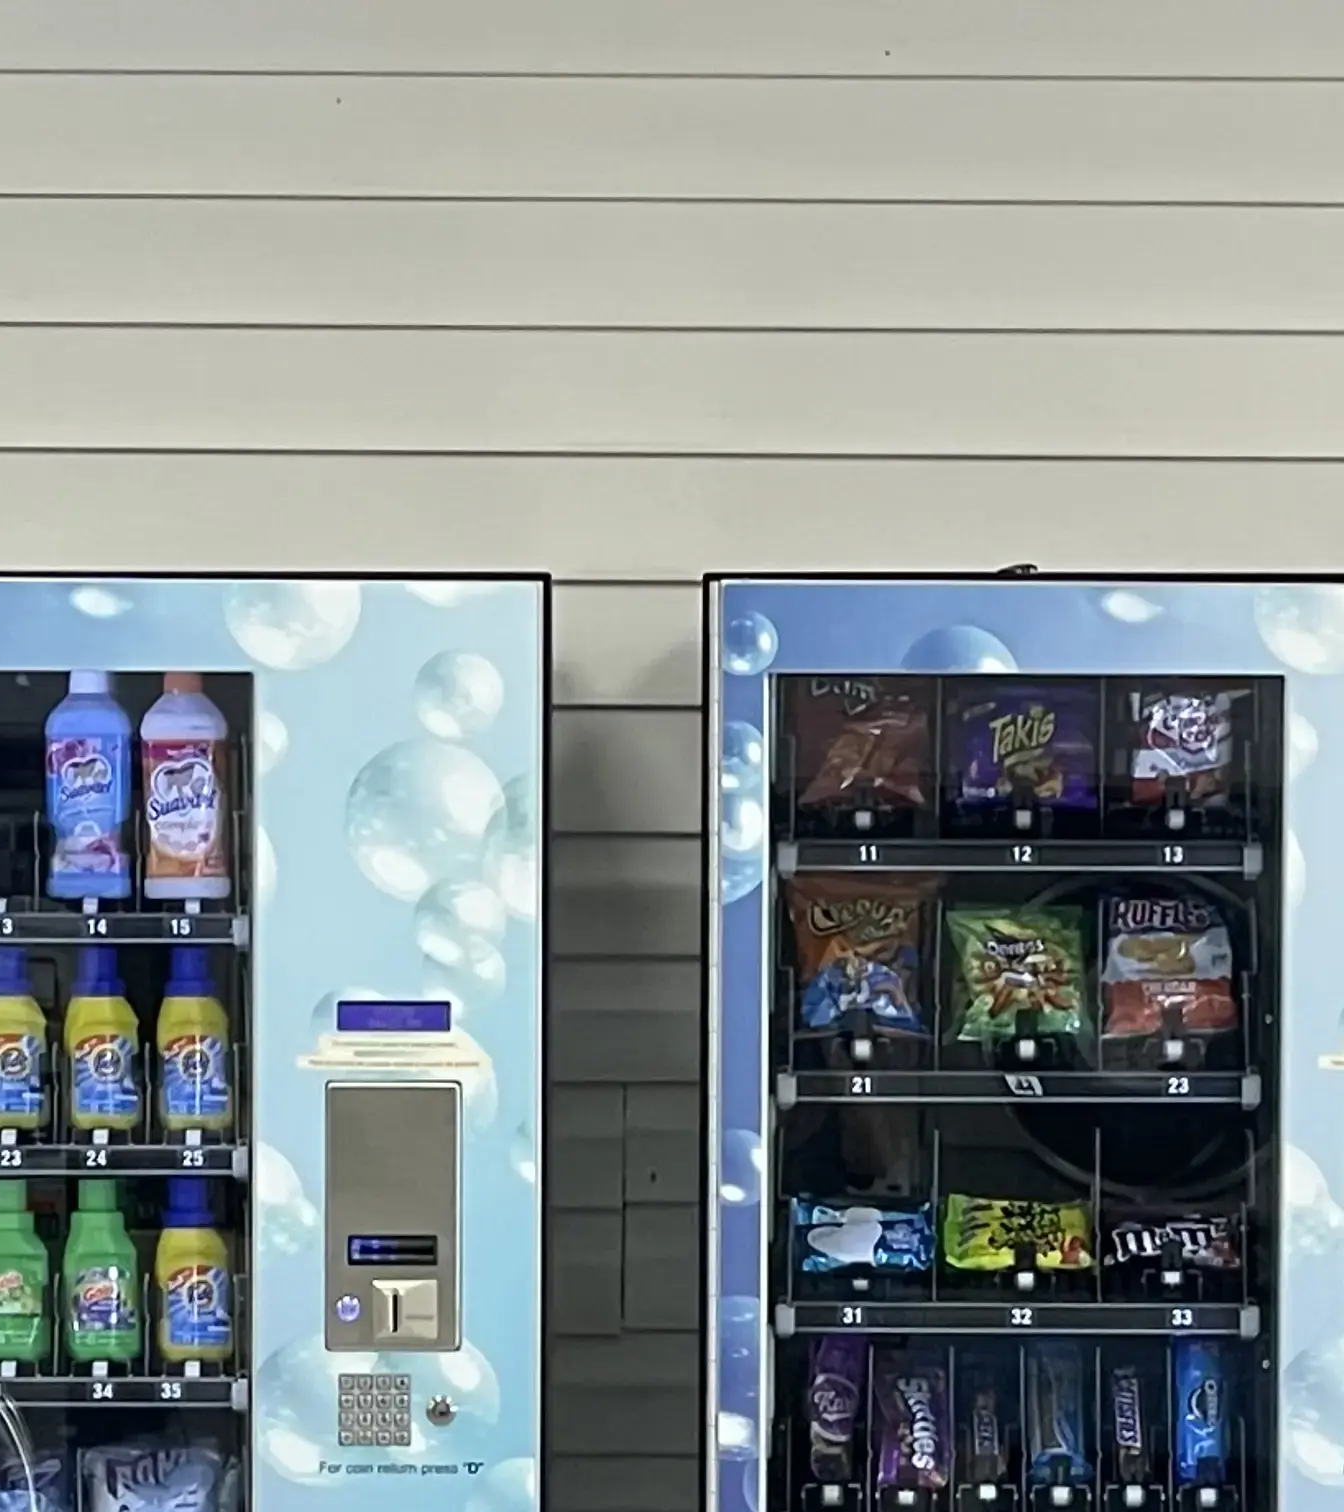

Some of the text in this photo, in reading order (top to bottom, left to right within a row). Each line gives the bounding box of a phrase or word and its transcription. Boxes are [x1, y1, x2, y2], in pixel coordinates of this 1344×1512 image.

[859, 845, 878, 861] 11
[1013, 845, 1032, 862] 12
[1164, 846, 1184, 863] 13
[87, 919, 107, 935] 14
[171, 919, 191, 935] 15
[851, 1077, 872, 1094] 21
[1168, 1077, 1189, 1094] 23
[0, 1149, 22, 1167] 23
[86, 1149, 107, 1167] 24
[182, 1149, 204, 1167] 25
[843, 1307, 862, 1324] 31
[1011, 1308, 1032, 1325] 32
[1171, 1309, 1192, 1326] 33
[92, 1382, 113, 1399] 34
[160, 1382, 181, 1399] 35
[319, 1461, 342, 1474] For
[377, 1462, 418, 1475] return
